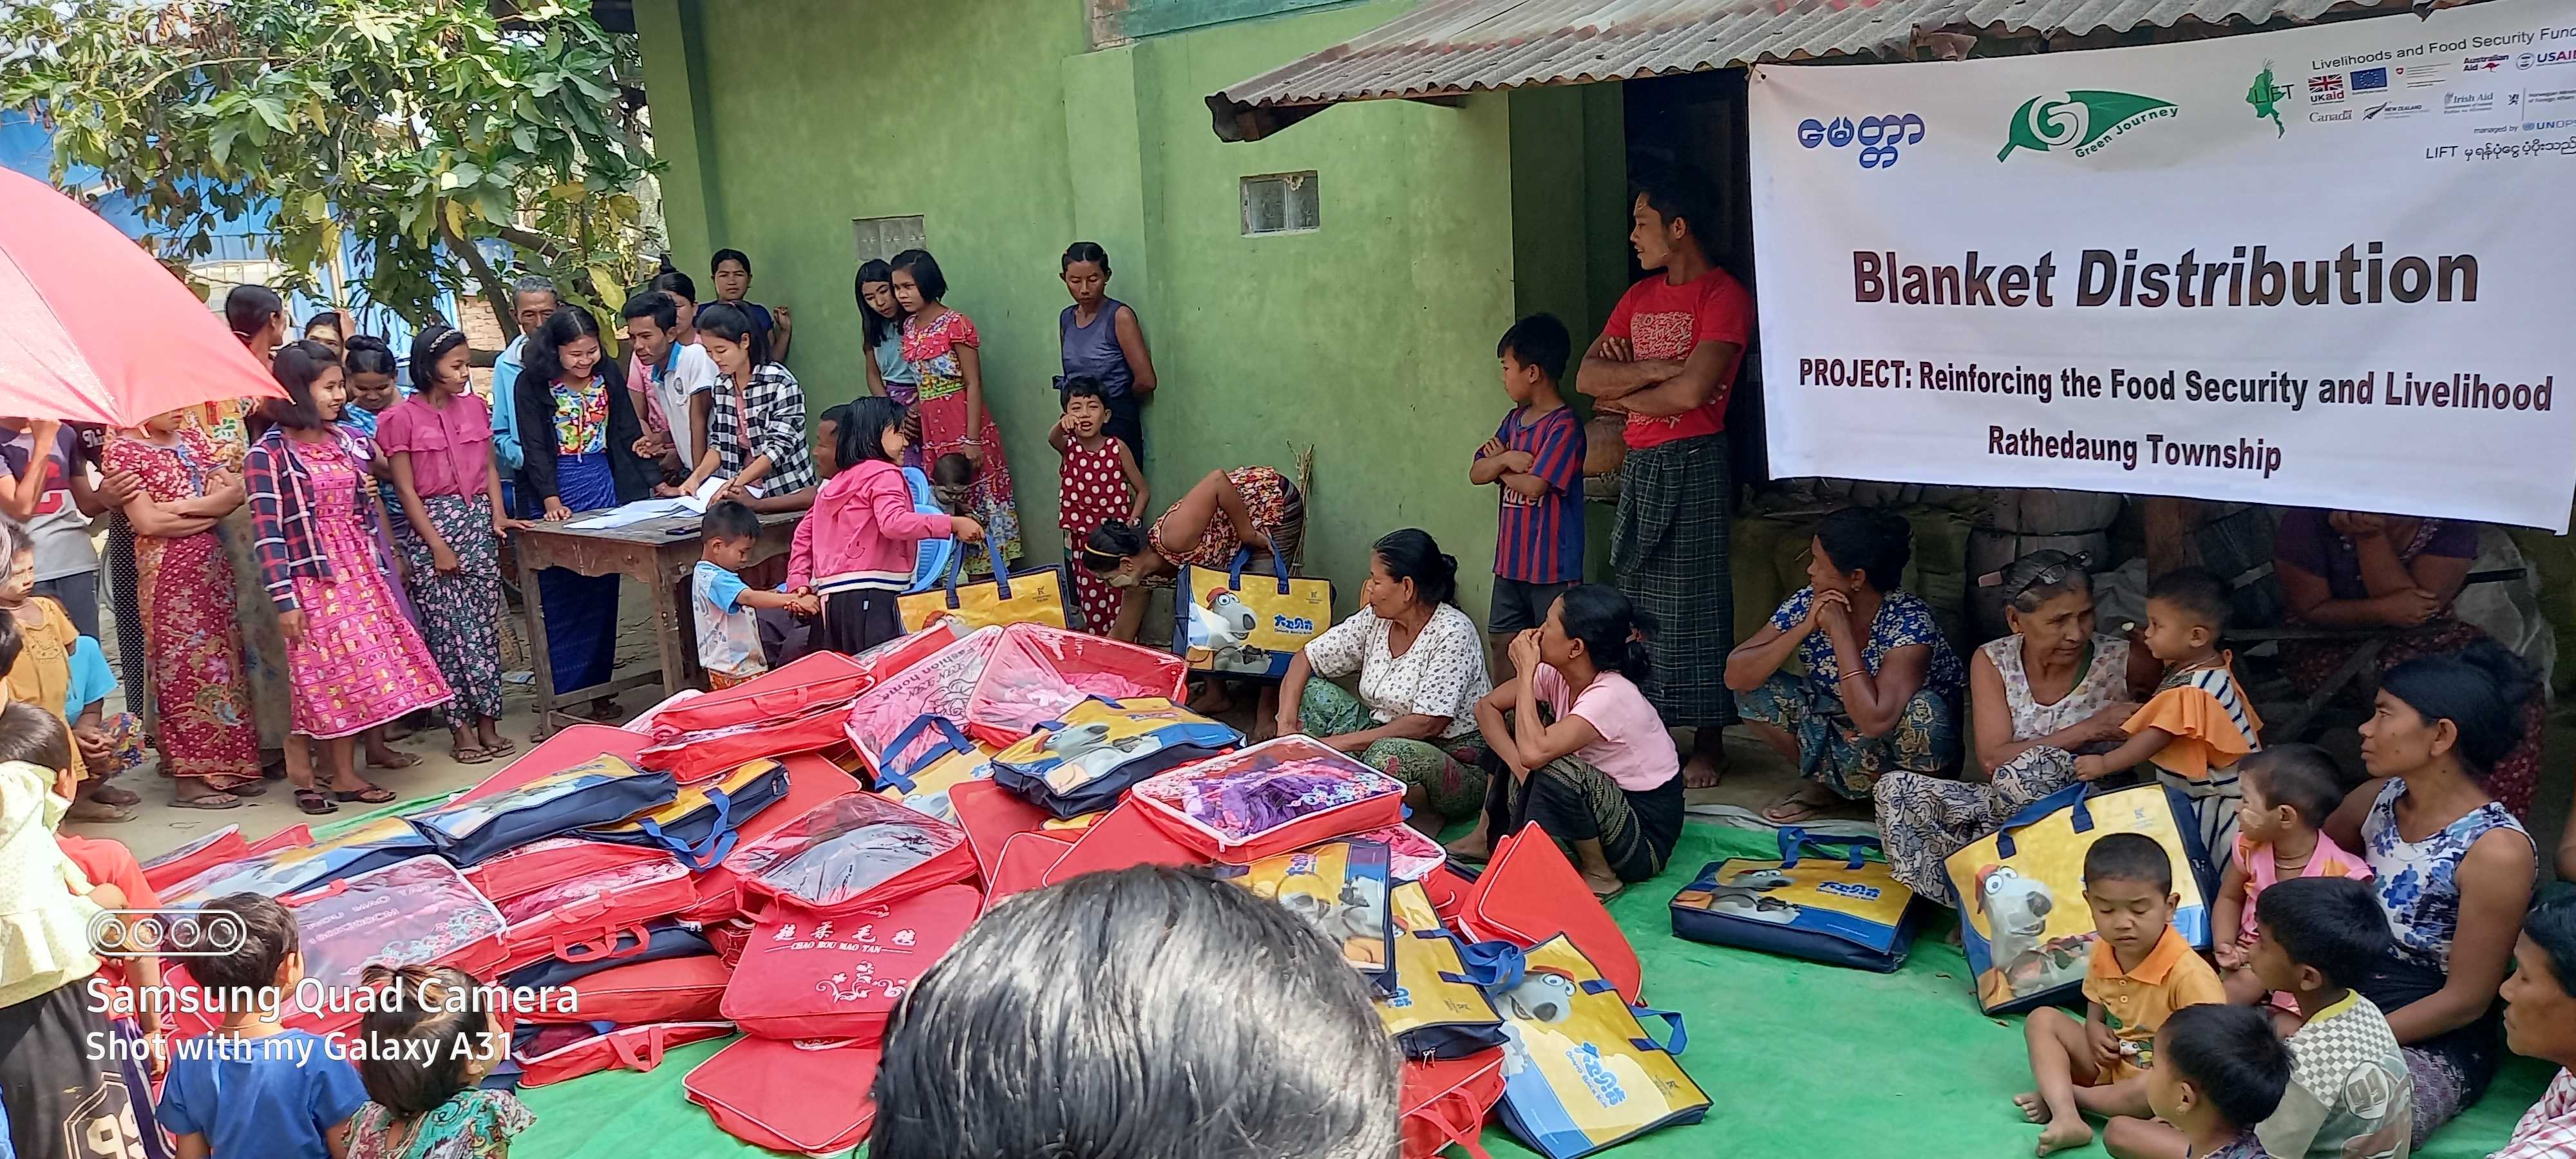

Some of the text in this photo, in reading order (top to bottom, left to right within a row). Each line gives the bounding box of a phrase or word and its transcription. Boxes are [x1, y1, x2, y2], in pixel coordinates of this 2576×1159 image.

[2312, 50, 2392, 70] Livelihoods
[2396, 43, 2423, 59] and
[2429, 39, 2467, 53] Food
[2472, 32, 2535, 48] Security
[2454, 94, 2474, 103] Irish
[2309, 110, 2353, 122] Canada
[2509, 124, 2519, 133] by
[2075, 107, 2179, 158] Green Journey
[2426, 146, 2459, 159] LIFT
[1853, 241, 2479, 307] Blanket Distribution
[1800, 358, 2553, 411] PROJECT: Reinforcing the Food Security and Livelihood
[1989, 425, 2282, 478] Rathedaung Township
[922, 646, 976, 674] Fashion
[862, 945, 882, 954] TAN
